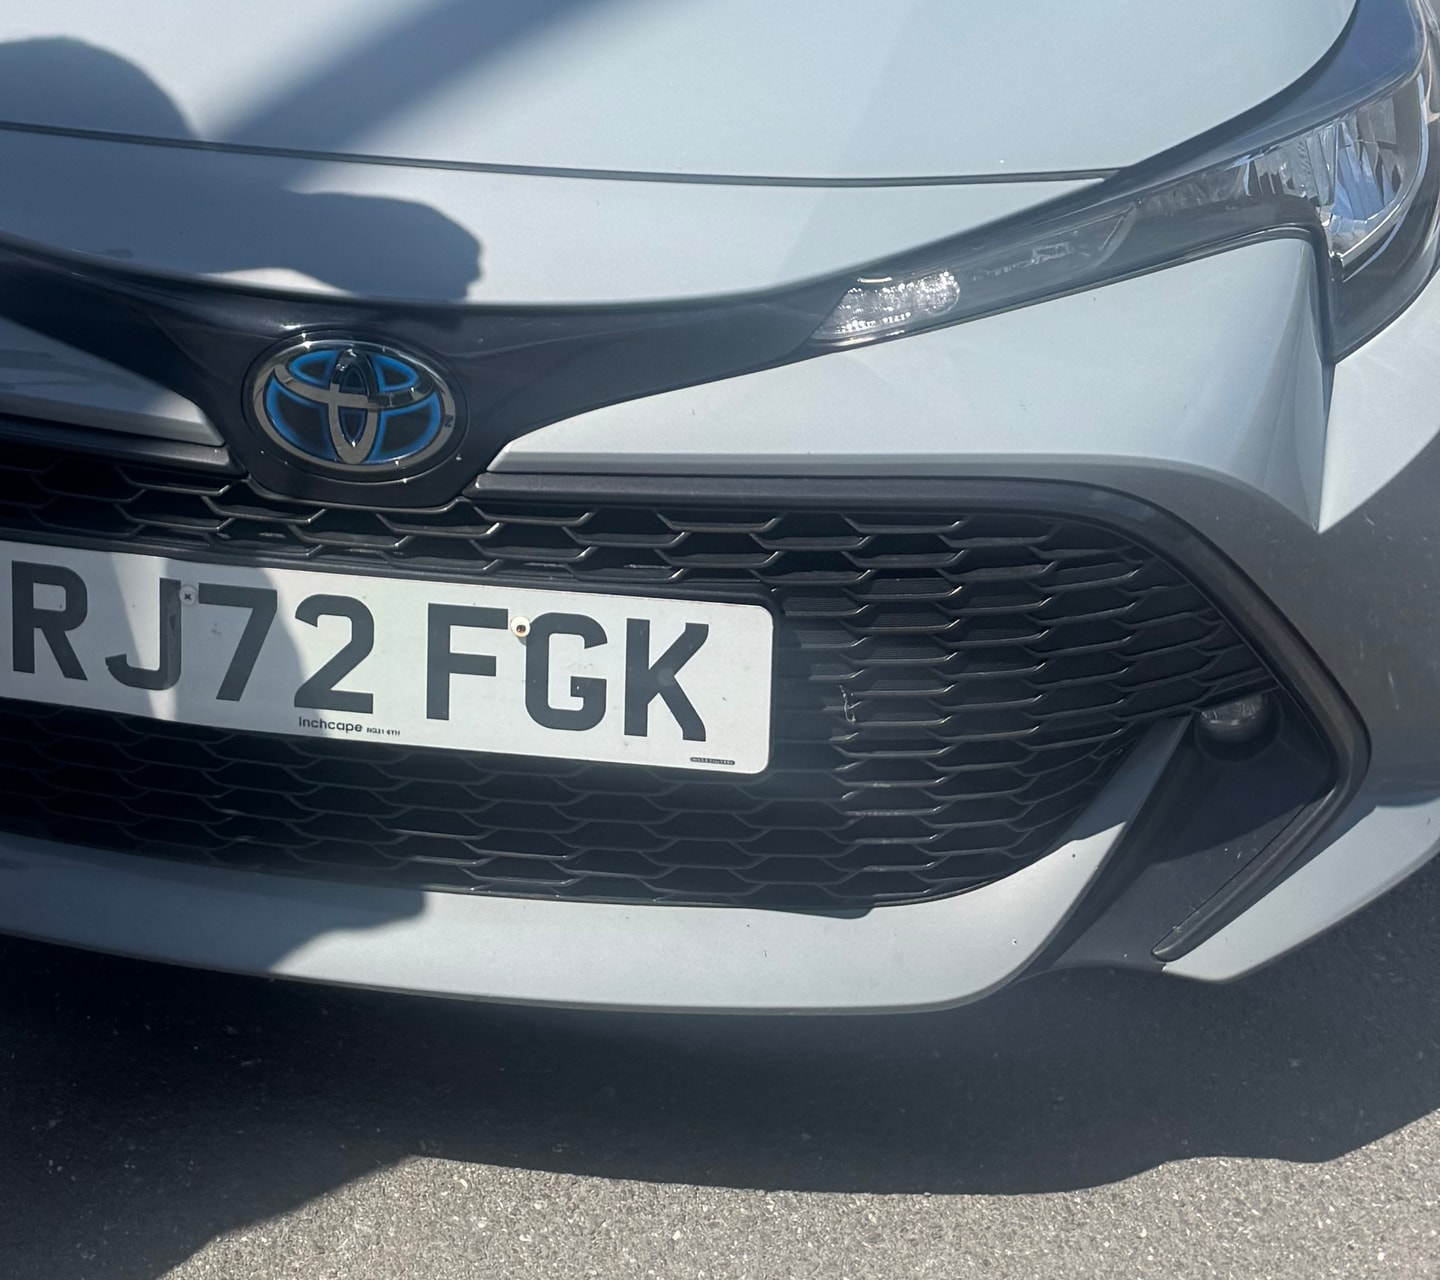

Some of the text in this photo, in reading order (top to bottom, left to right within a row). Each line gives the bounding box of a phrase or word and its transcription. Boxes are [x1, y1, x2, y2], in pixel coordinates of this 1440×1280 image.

[10, 559, 710, 742] RJ72 FGK
[298, 716, 363, 734] Inchcape
